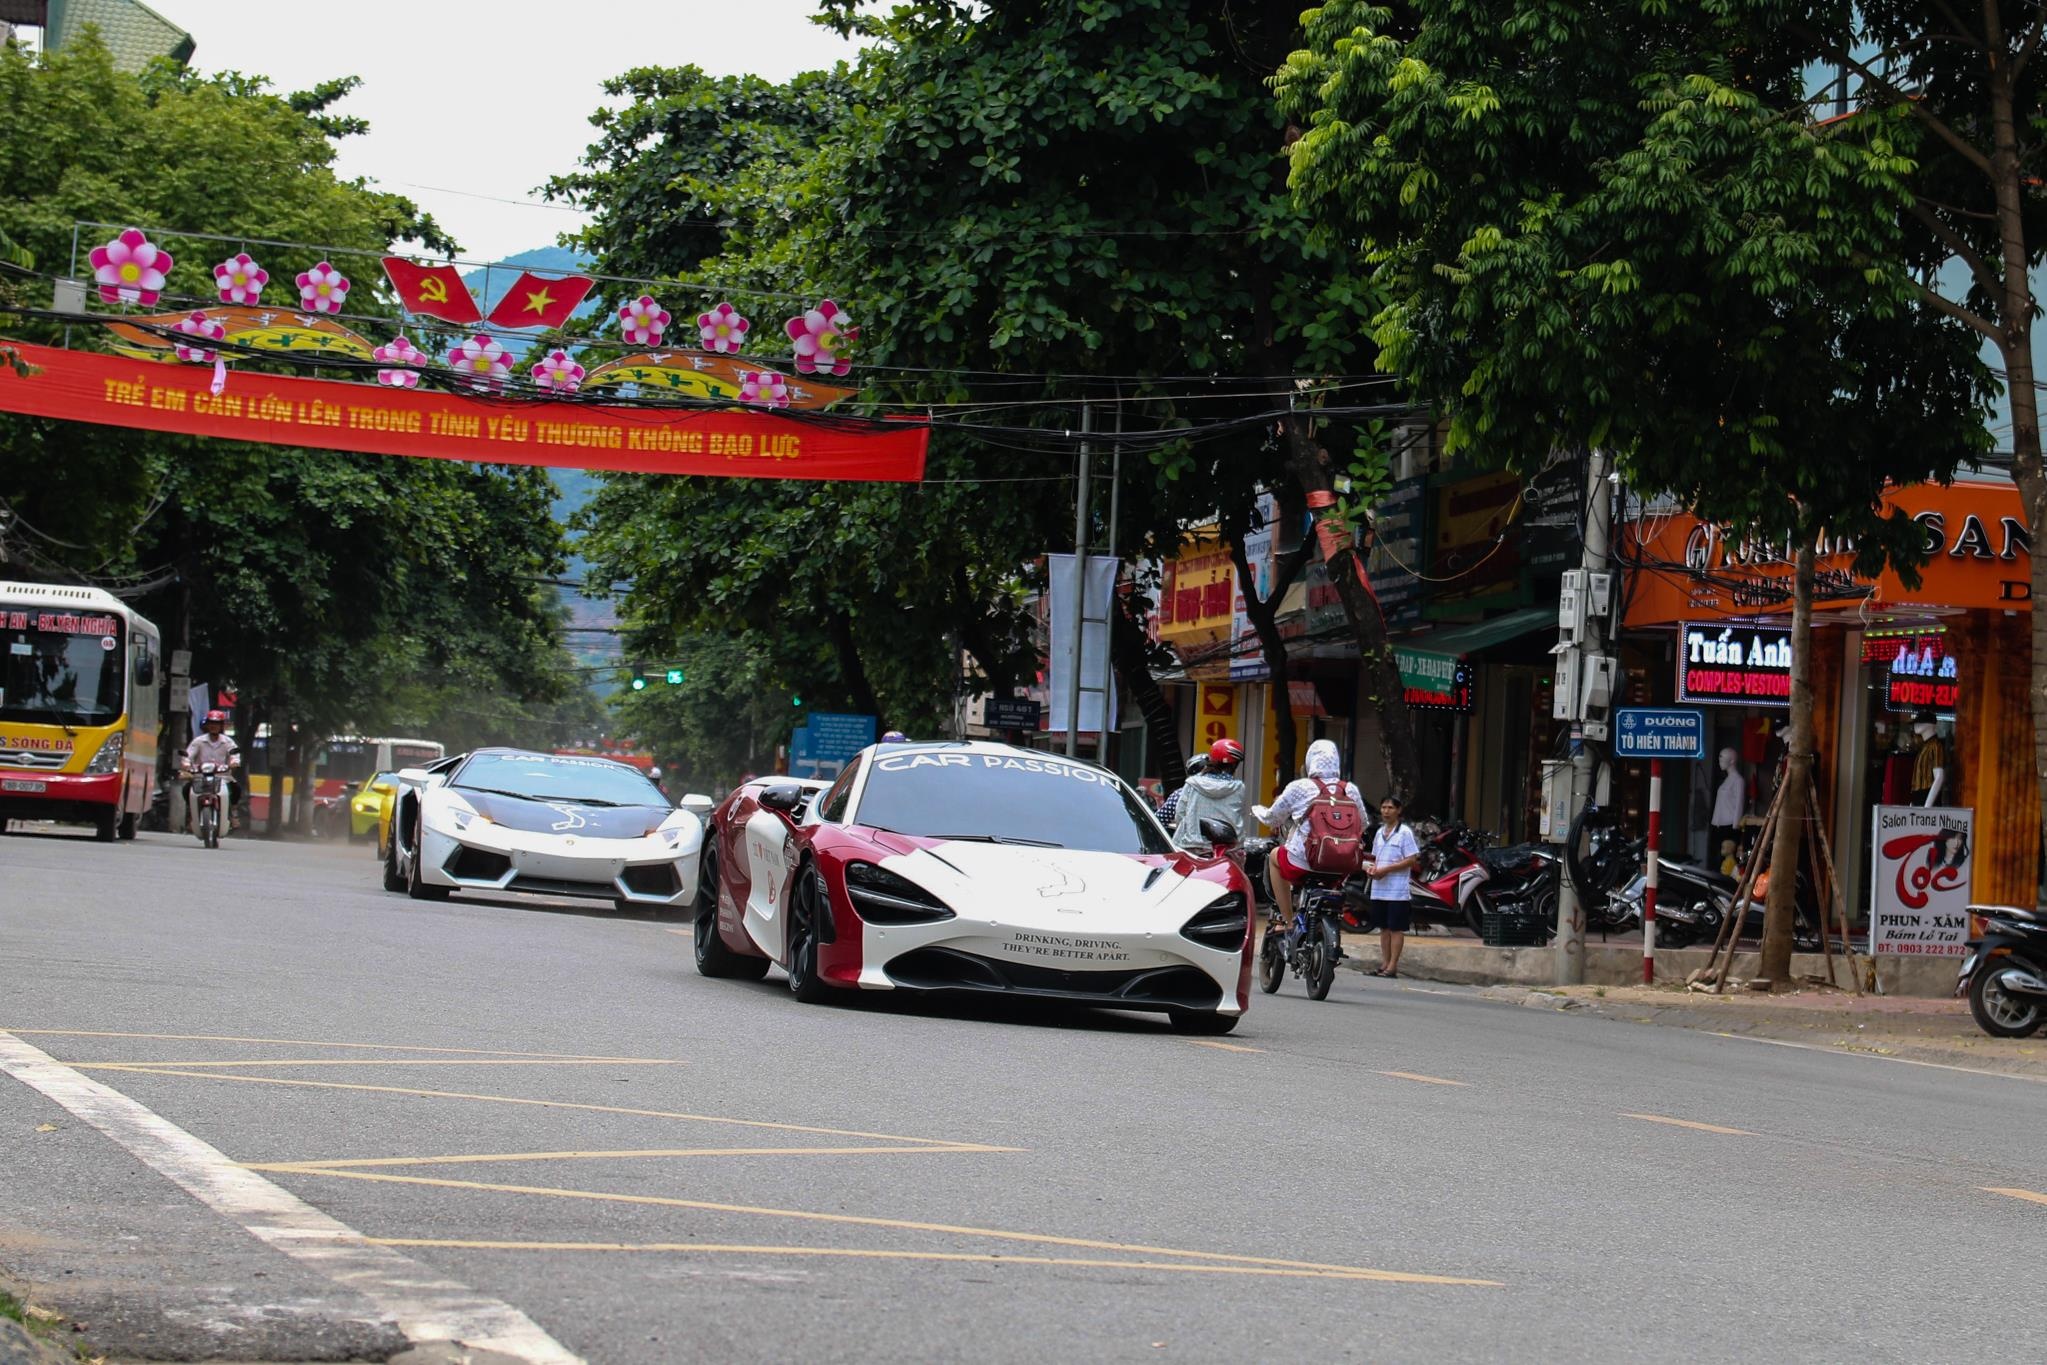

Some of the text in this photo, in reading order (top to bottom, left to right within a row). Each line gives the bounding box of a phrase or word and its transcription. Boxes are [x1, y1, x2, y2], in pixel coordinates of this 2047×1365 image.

[104, 375, 146, 406] TRẺ
[151, 386, 186, 412] EM
[247, 392, 292, 423] LỚN
[298, 399, 341, 427] LÊN
[348, 406, 422, 433] TRONG
[430, 409, 480, 438] TÌNH
[487, 414, 529, 442] YÊU
[536, 421, 622, 449] THƯƠNG
[628, 424, 703, 453] KHÔNG
[709, 433, 752, 460] BẠO
[760, 433, 801, 462] LỰC
[9, 612, 28, 630] AN
[1688, 628, 1792, 668] Tuấn Anh
[1644, 715, 1696, 727] ĐƯỜNG
[1621, 730, 1697, 751] TÔ HIẾN THÀNH
[551, 757, 615, 769] PASSION
[878, 753, 1122, 793] CAR PASSION
[1882, 812, 1968, 832] Salon Trang Nhung
[1881, 834, 1968, 909] Tóc
[1880, 914, 1920, 927] PHUN
[1933, 914, 1966, 929] XĂM
[1015, 932, 1122, 950] DRINKING, DRIVING.
[1937, 931, 1959, 942] Tai
[1002, 943, 1131, 961] THEY'RE BETTER APART.
[1897, 944, 1922, 954] 0903
[1925, 945, 1944, 954] 222
